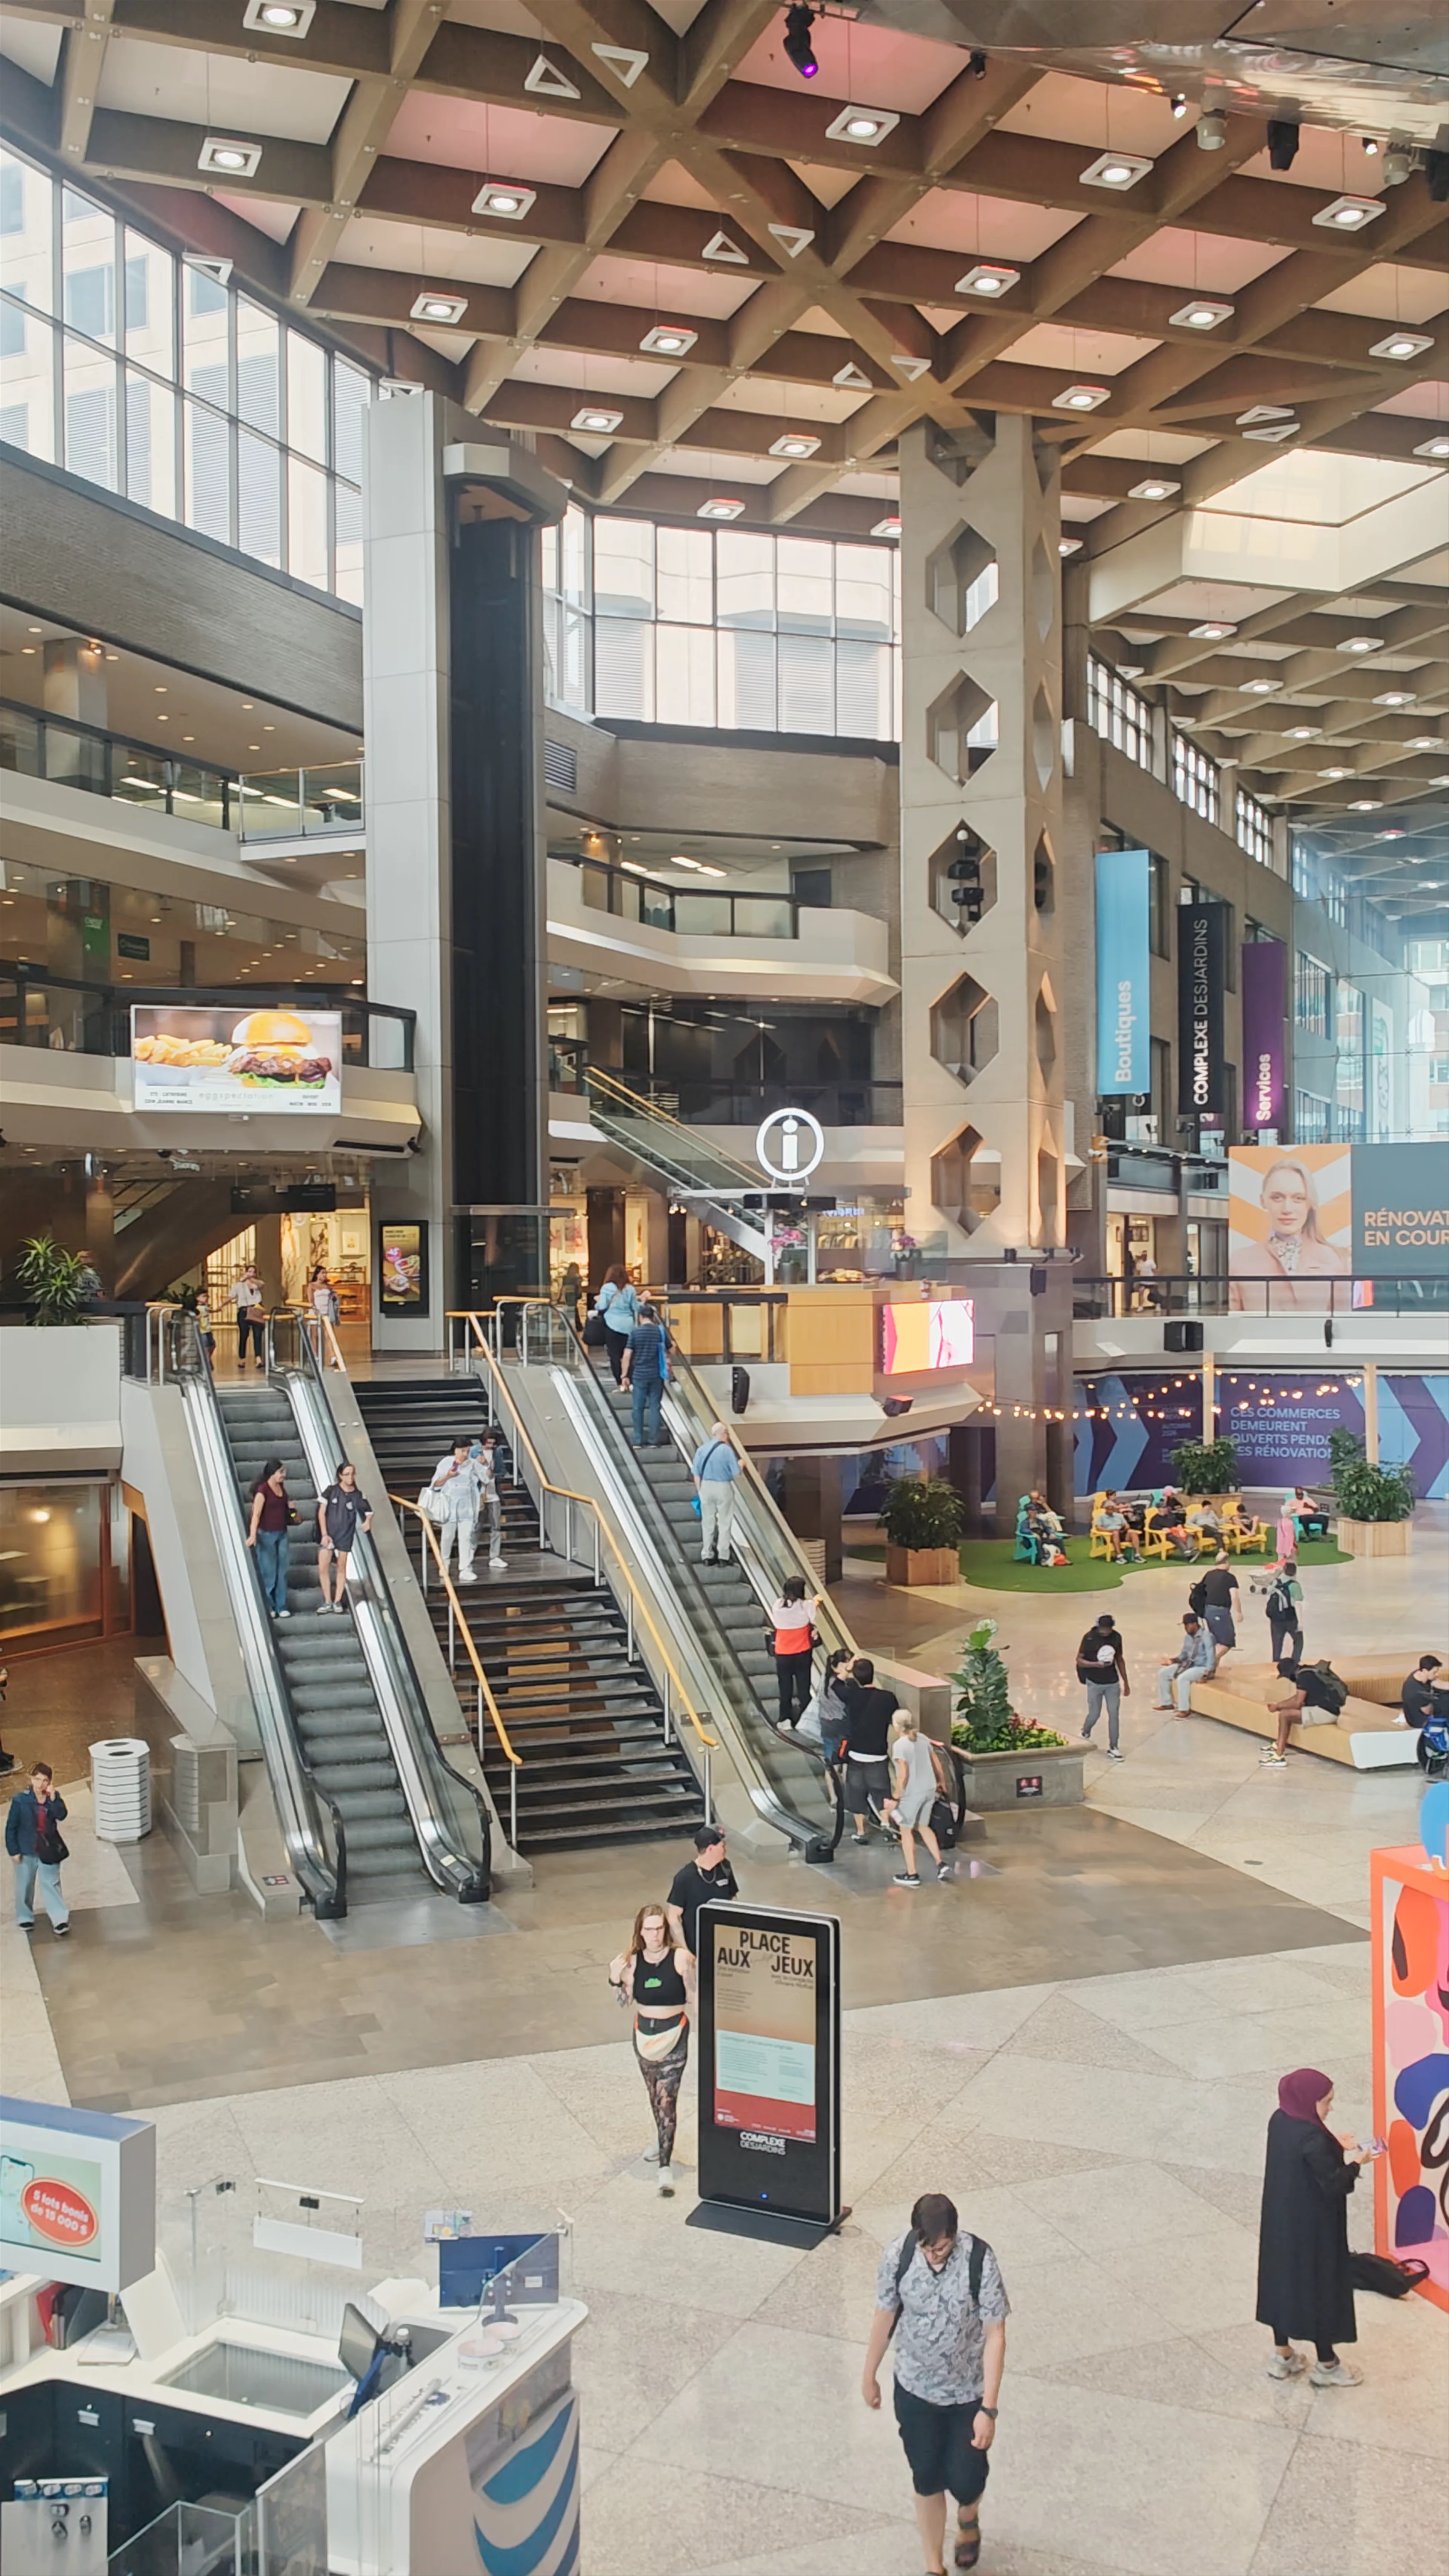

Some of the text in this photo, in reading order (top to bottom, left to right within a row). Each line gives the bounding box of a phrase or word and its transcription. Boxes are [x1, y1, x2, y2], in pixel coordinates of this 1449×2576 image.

[1194, 919, 1208, 1015] DESJARDINS
[1114, 980, 1137, 1082] Boutiques
[1194, 1020, 1208, 1105] COMPLEXE
[1256, 1053, 1272, 1121] Services
[1365, 1230, 1449, 1246] EN COUR
[1230, 1407, 1341, 1419] CES COMMERCES
[1231, 1420, 1307, 1432] DEMEURENT
[1231, 1433, 1287, 1444] OUVERTS
[1236, 1446, 1252, 1456] ES
[740, 1930, 791, 1954] PLACE
[717, 1947, 750, 1969] AUX
[771, 1955, 813, 1977] JEUX
[740, 2131, 786, 2147] COMPLEXE
[740, 2140, 786, 2156] DESJARDINS
[31, 2203, 43, 2216] de
[41, 2193, 60, 2210] lots
